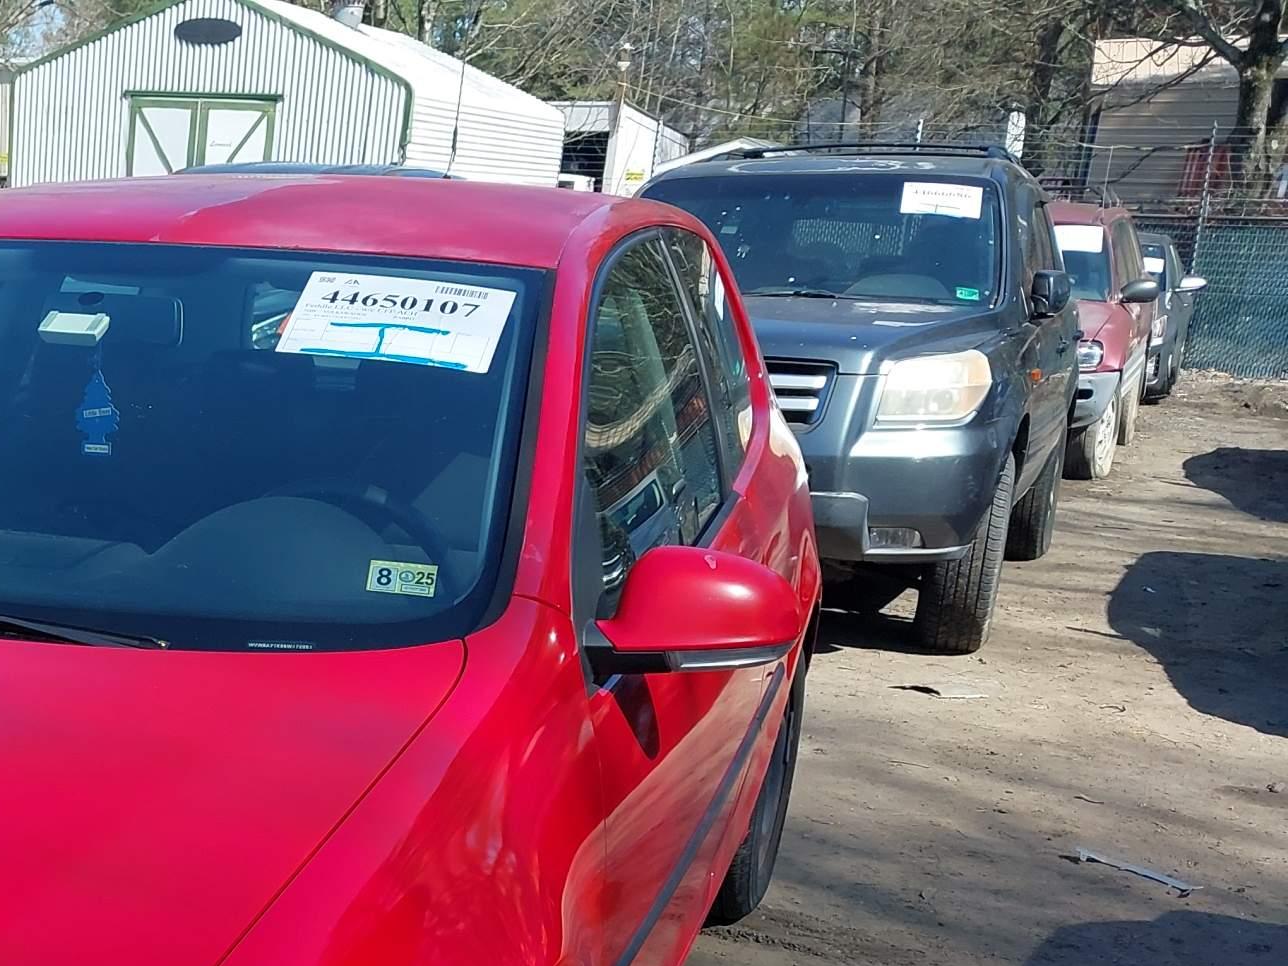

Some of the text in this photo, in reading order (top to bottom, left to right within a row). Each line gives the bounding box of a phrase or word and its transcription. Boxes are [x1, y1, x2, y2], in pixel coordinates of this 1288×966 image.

[321, 290, 481, 318] 44650107
[376, 567, 435, 586] 8 25
